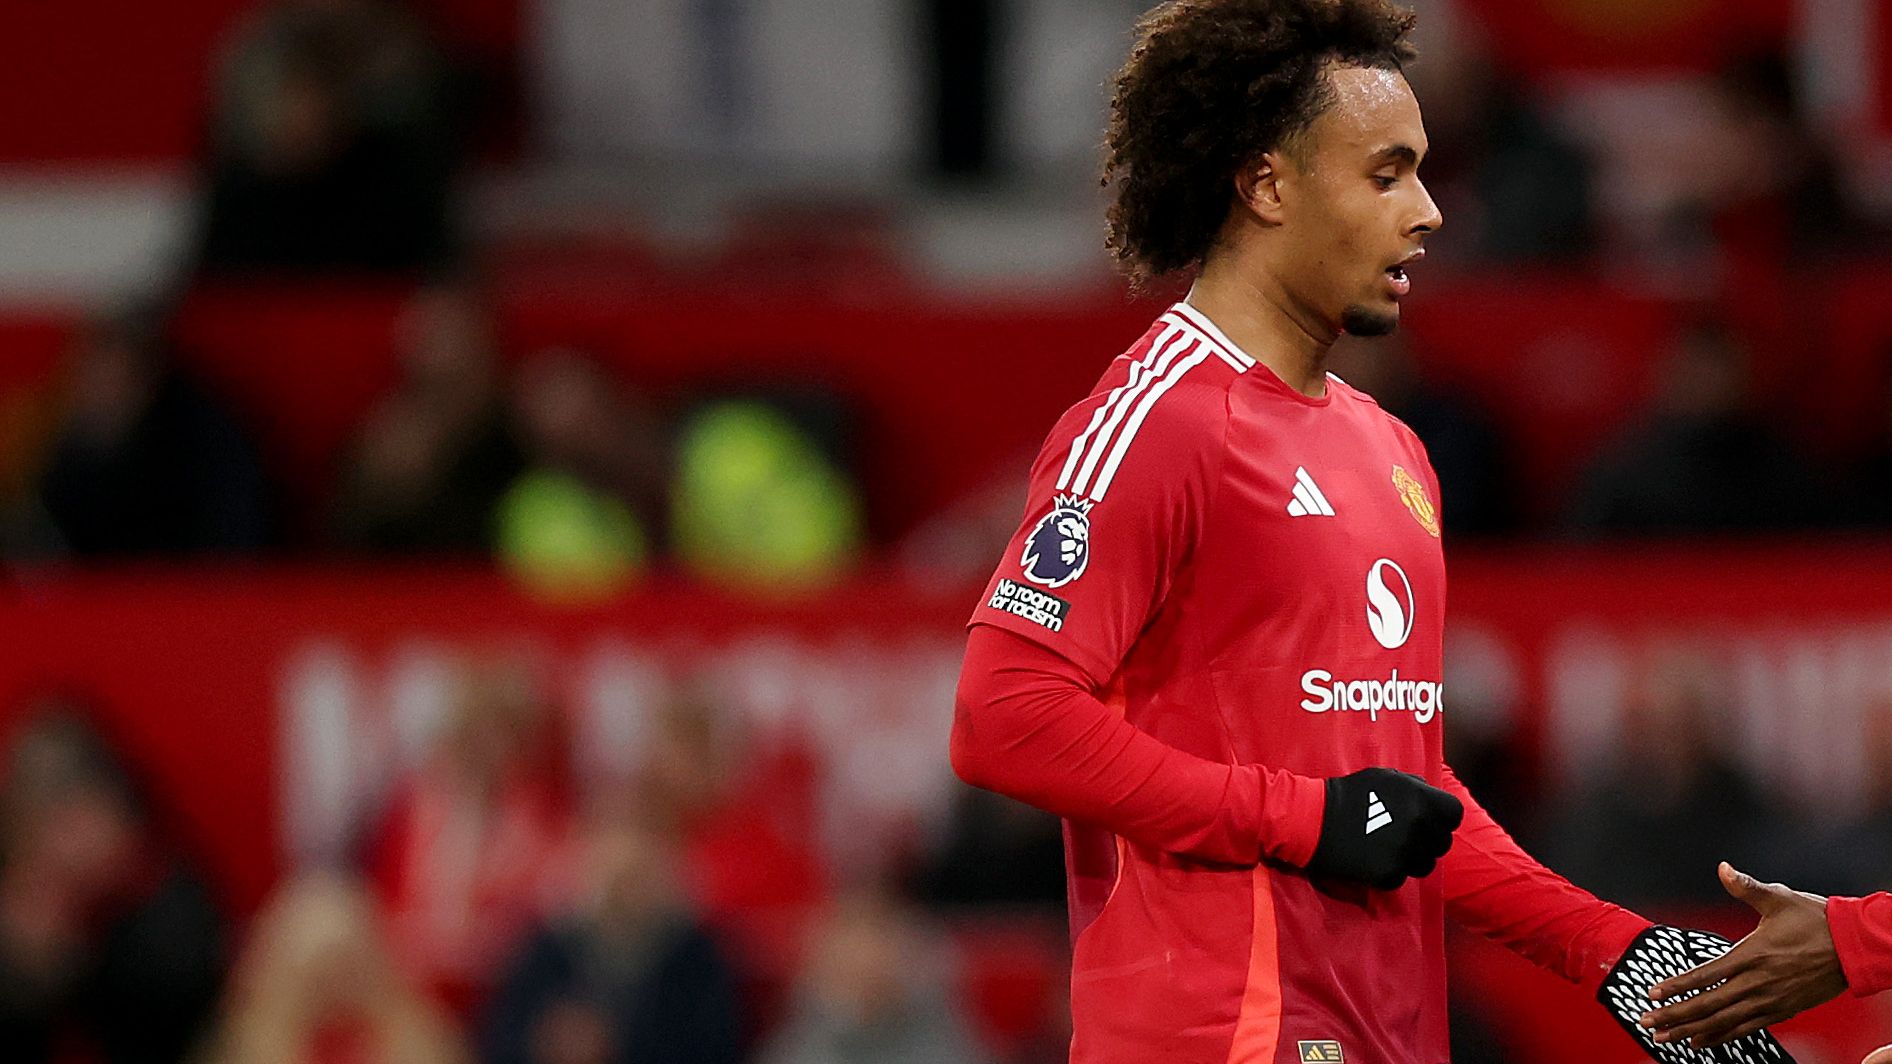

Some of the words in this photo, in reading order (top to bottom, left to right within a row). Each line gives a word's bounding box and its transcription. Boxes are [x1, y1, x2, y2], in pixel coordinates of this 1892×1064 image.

[995, 578, 1017, 597] No
[1014, 586, 1061, 616] room
[1006, 600, 1063, 632] racism
